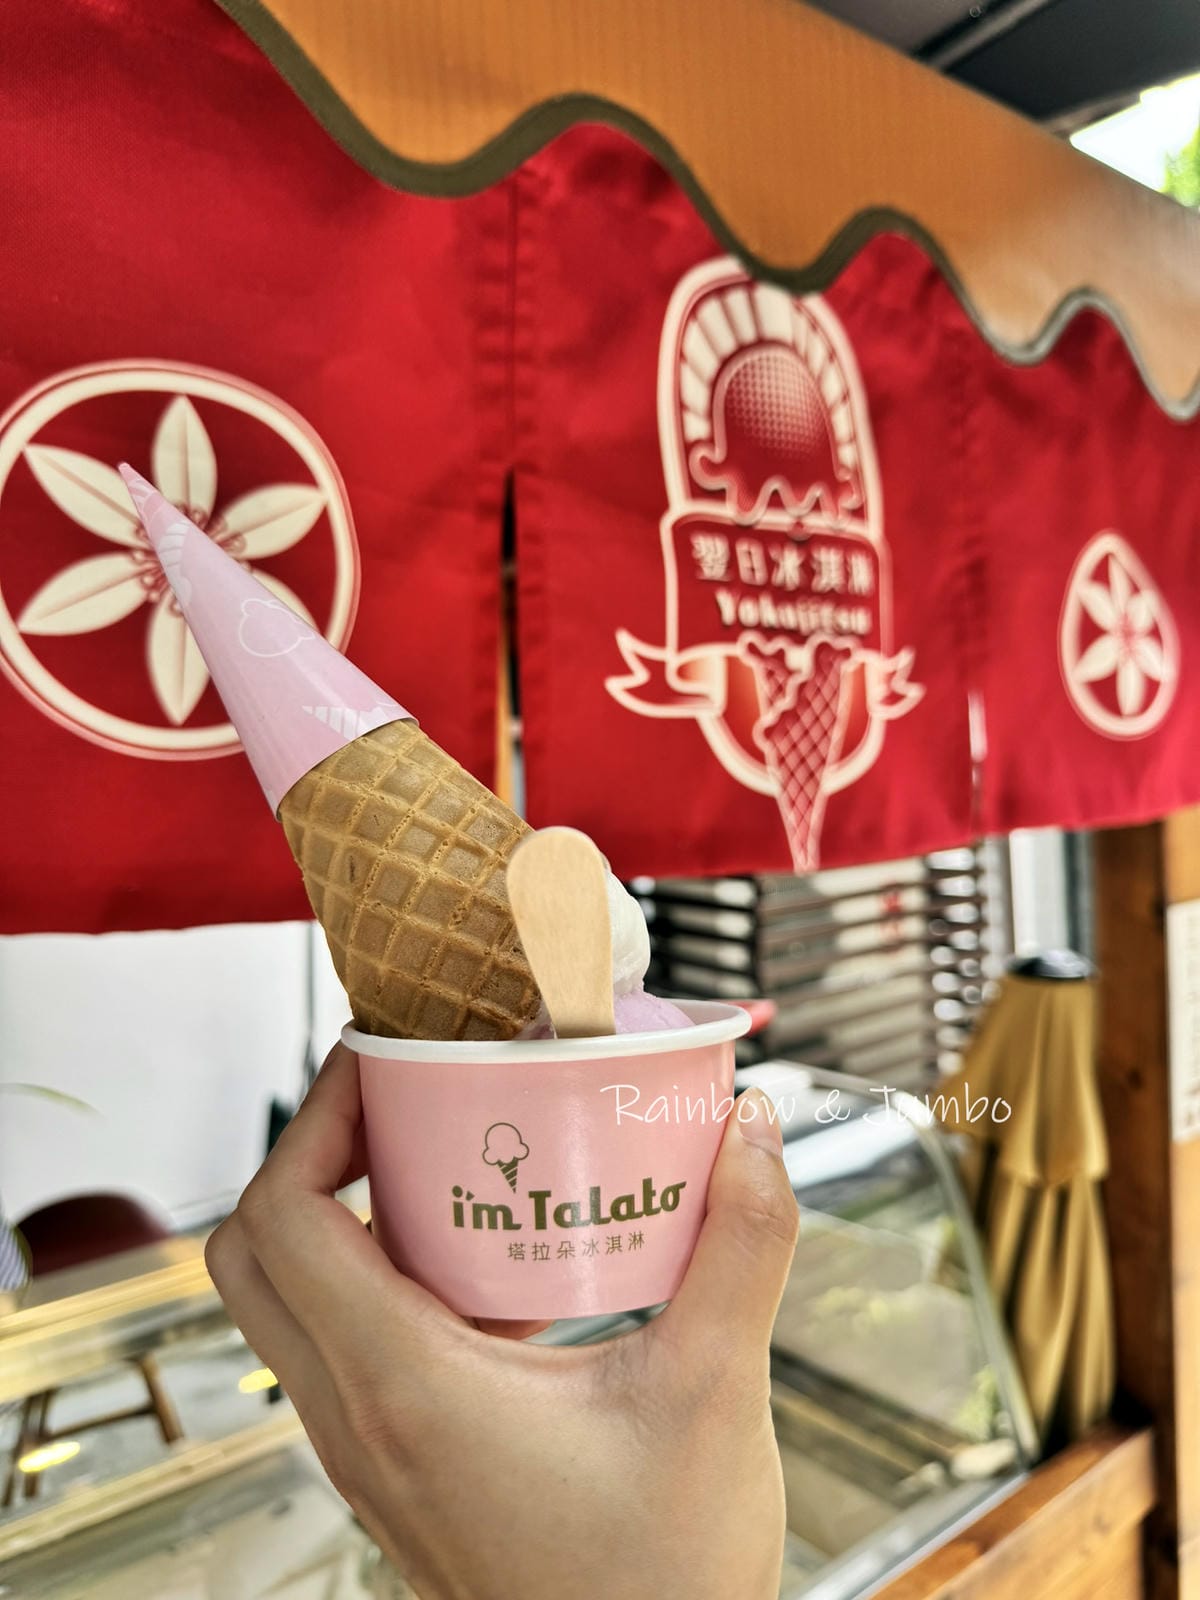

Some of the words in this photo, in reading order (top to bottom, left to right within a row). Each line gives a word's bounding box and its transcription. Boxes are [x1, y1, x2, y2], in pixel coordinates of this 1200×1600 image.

[451, 1185, 522, 1231] i'm
[528, 1176, 687, 1231] Talato
[506, 1230, 646, 1262] 塔拉朵冰淇淋
